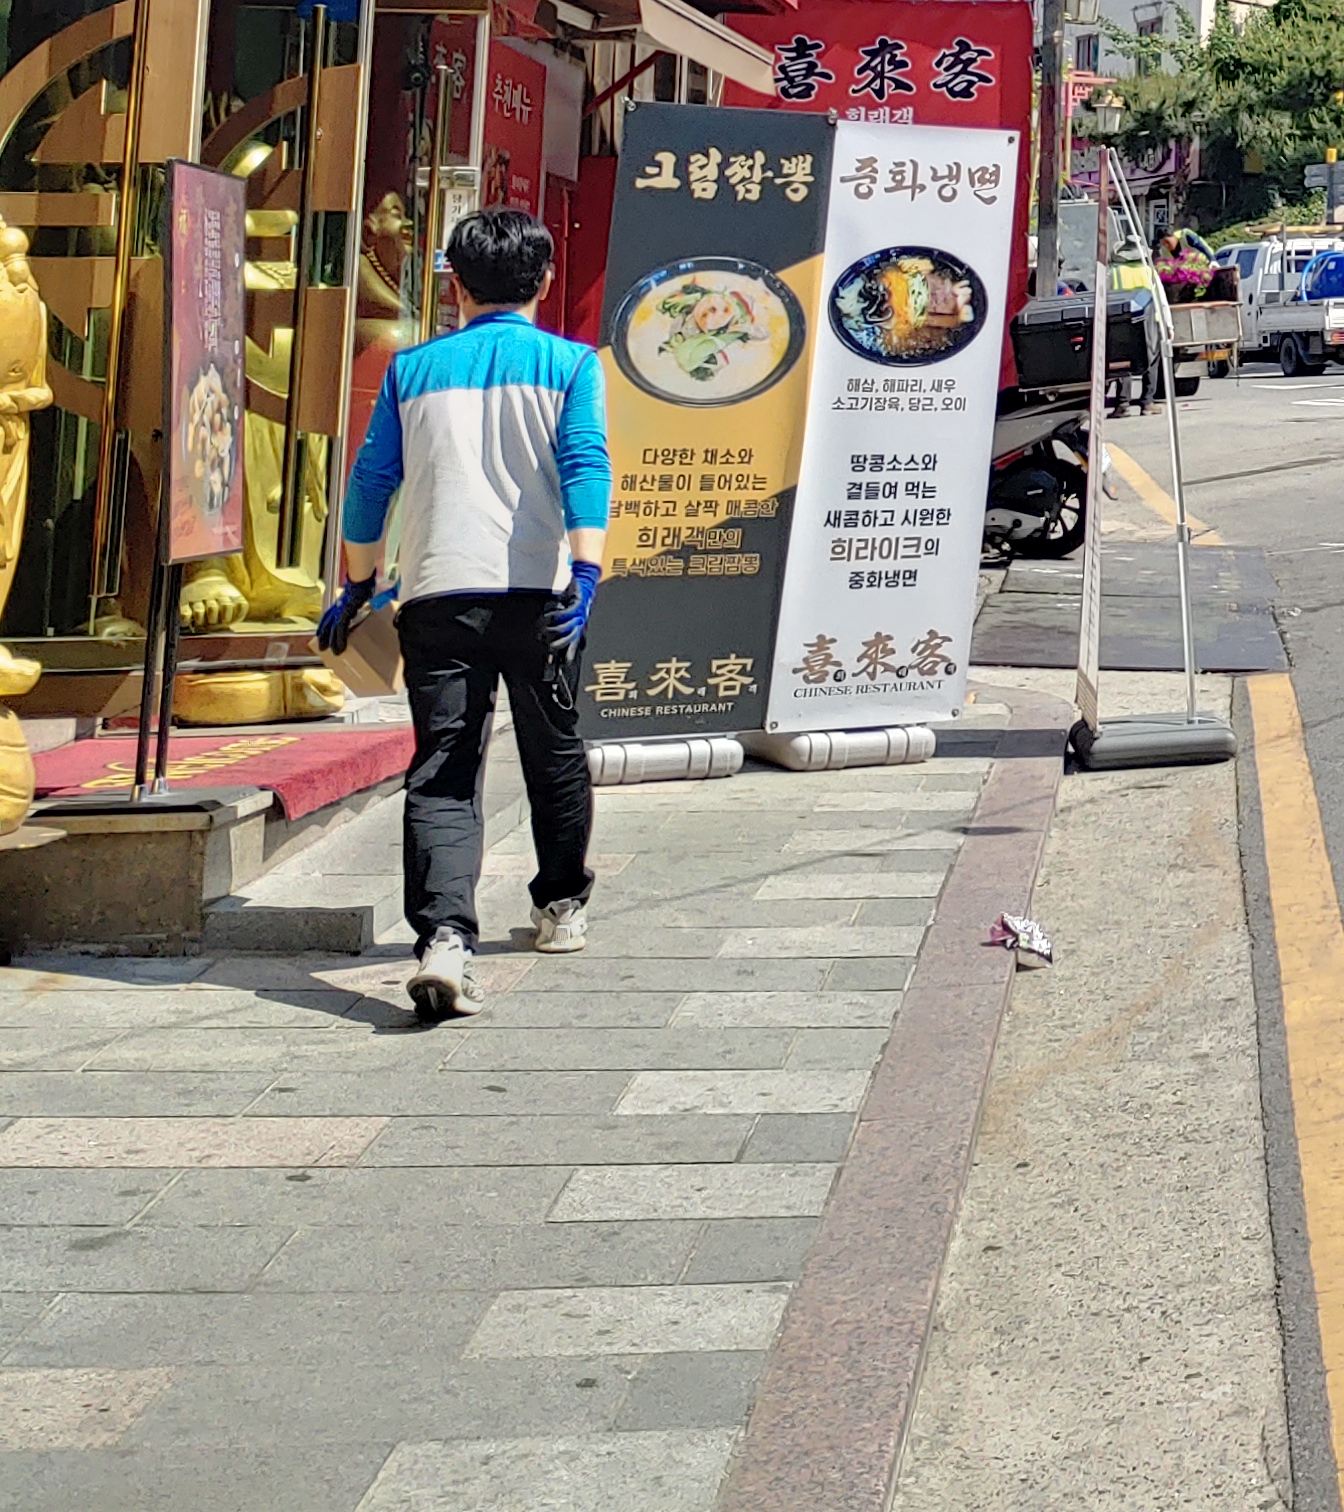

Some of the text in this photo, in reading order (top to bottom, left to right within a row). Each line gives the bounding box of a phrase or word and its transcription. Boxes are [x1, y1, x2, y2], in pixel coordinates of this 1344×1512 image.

[634, 146, 815, 202] 크림짬뽕
[839, 155, 1002, 206] 중화냉면
[847, 378, 956, 394] 해삼, 해파리, 새우
[831, 396, 966, 412] 소고기장육, 당근, 오이
[642, 447, 753, 466] 다양한 채소와
[850, 453, 938, 472] 땅콩소스와
[621, 473, 767, 492] 해산물이 들어있는
[846, 481, 937, 500] 곁들여 먹는
[684, 500, 720, 518] 살짝
[725, 498, 779, 518] 매콤한
[824, 507, 952, 529] 새콤하고 시원한
[636, 526, 743, 550] 희래객만의
[829, 536, 940, 562] 희라이크의
[611, 553, 760, 578] 특색있는 크림짬뽕
[848, 569, 918, 590] 중화냉면
[792, 629, 953, 685] 喜來客
[585, 654, 754, 702] 喜來客
[793, 679, 945, 699] CHINESE RESTAURANT
[600, 701, 735, 718] CHINESE RESTAURANT
